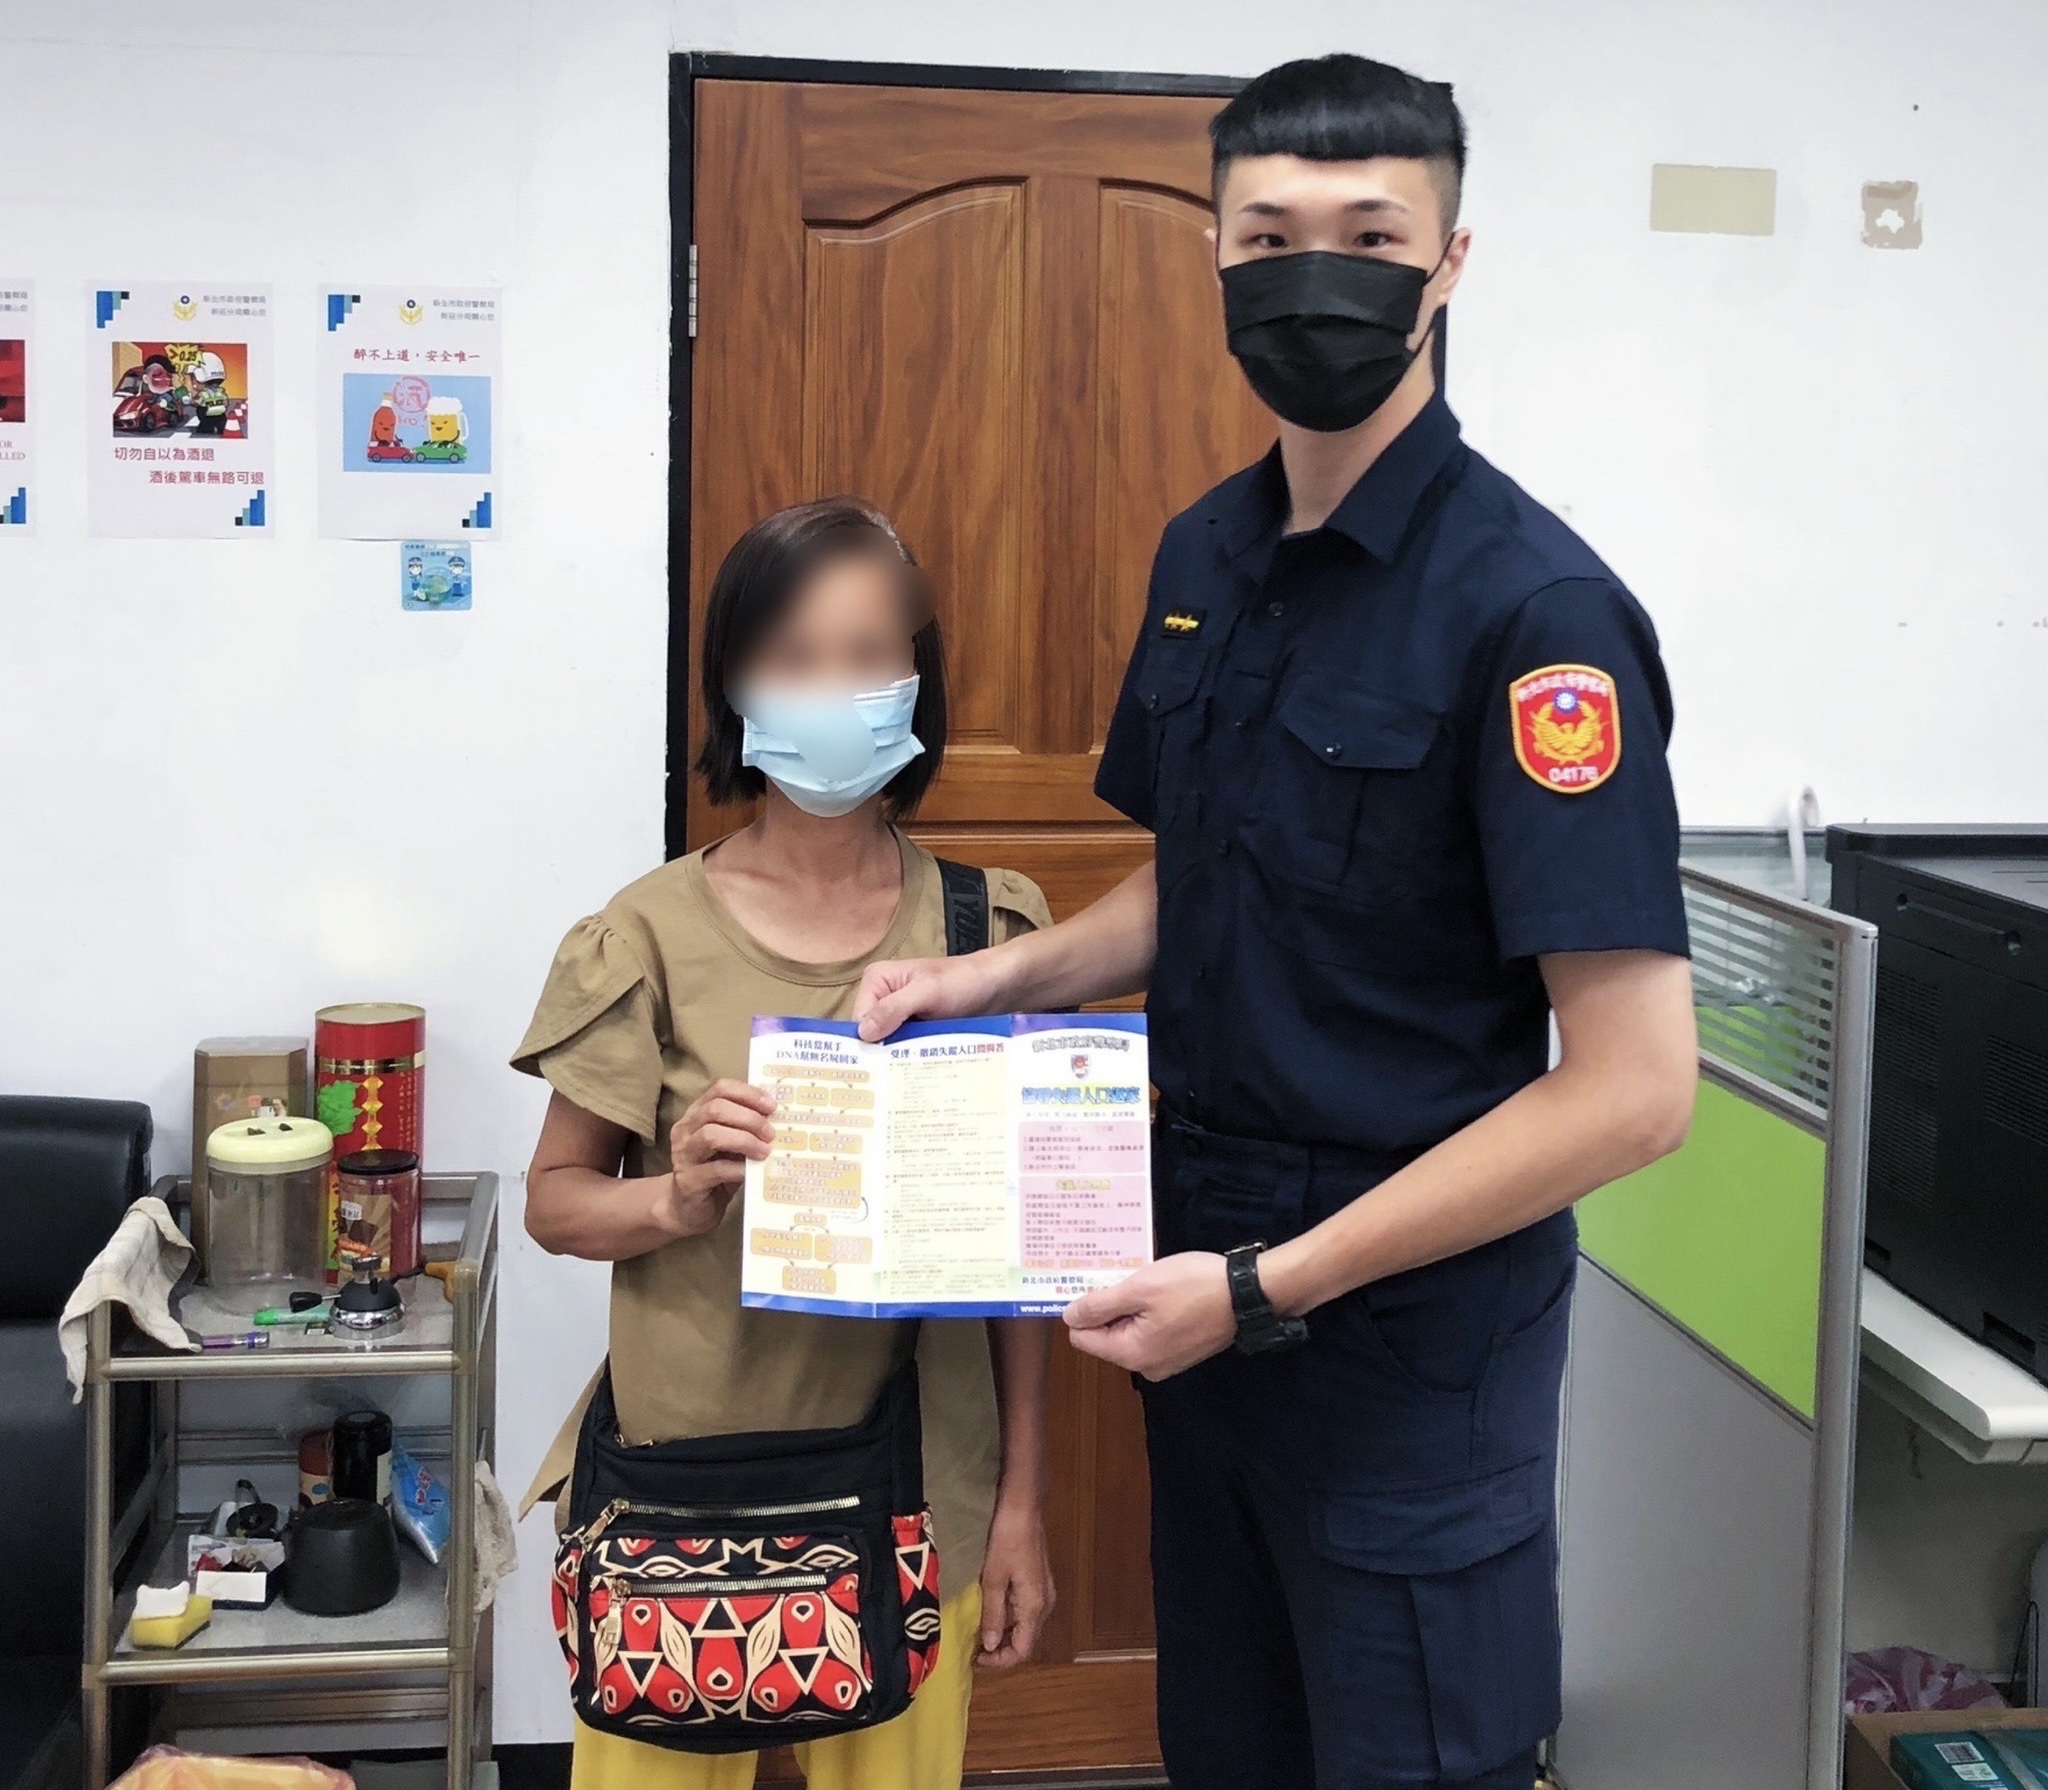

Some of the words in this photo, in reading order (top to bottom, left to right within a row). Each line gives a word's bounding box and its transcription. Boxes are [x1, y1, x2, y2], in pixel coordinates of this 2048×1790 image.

[114, 447, 214, 461] 切勿自以為酒退
[149, 470, 265, 485] 酒後駕車無路可退
